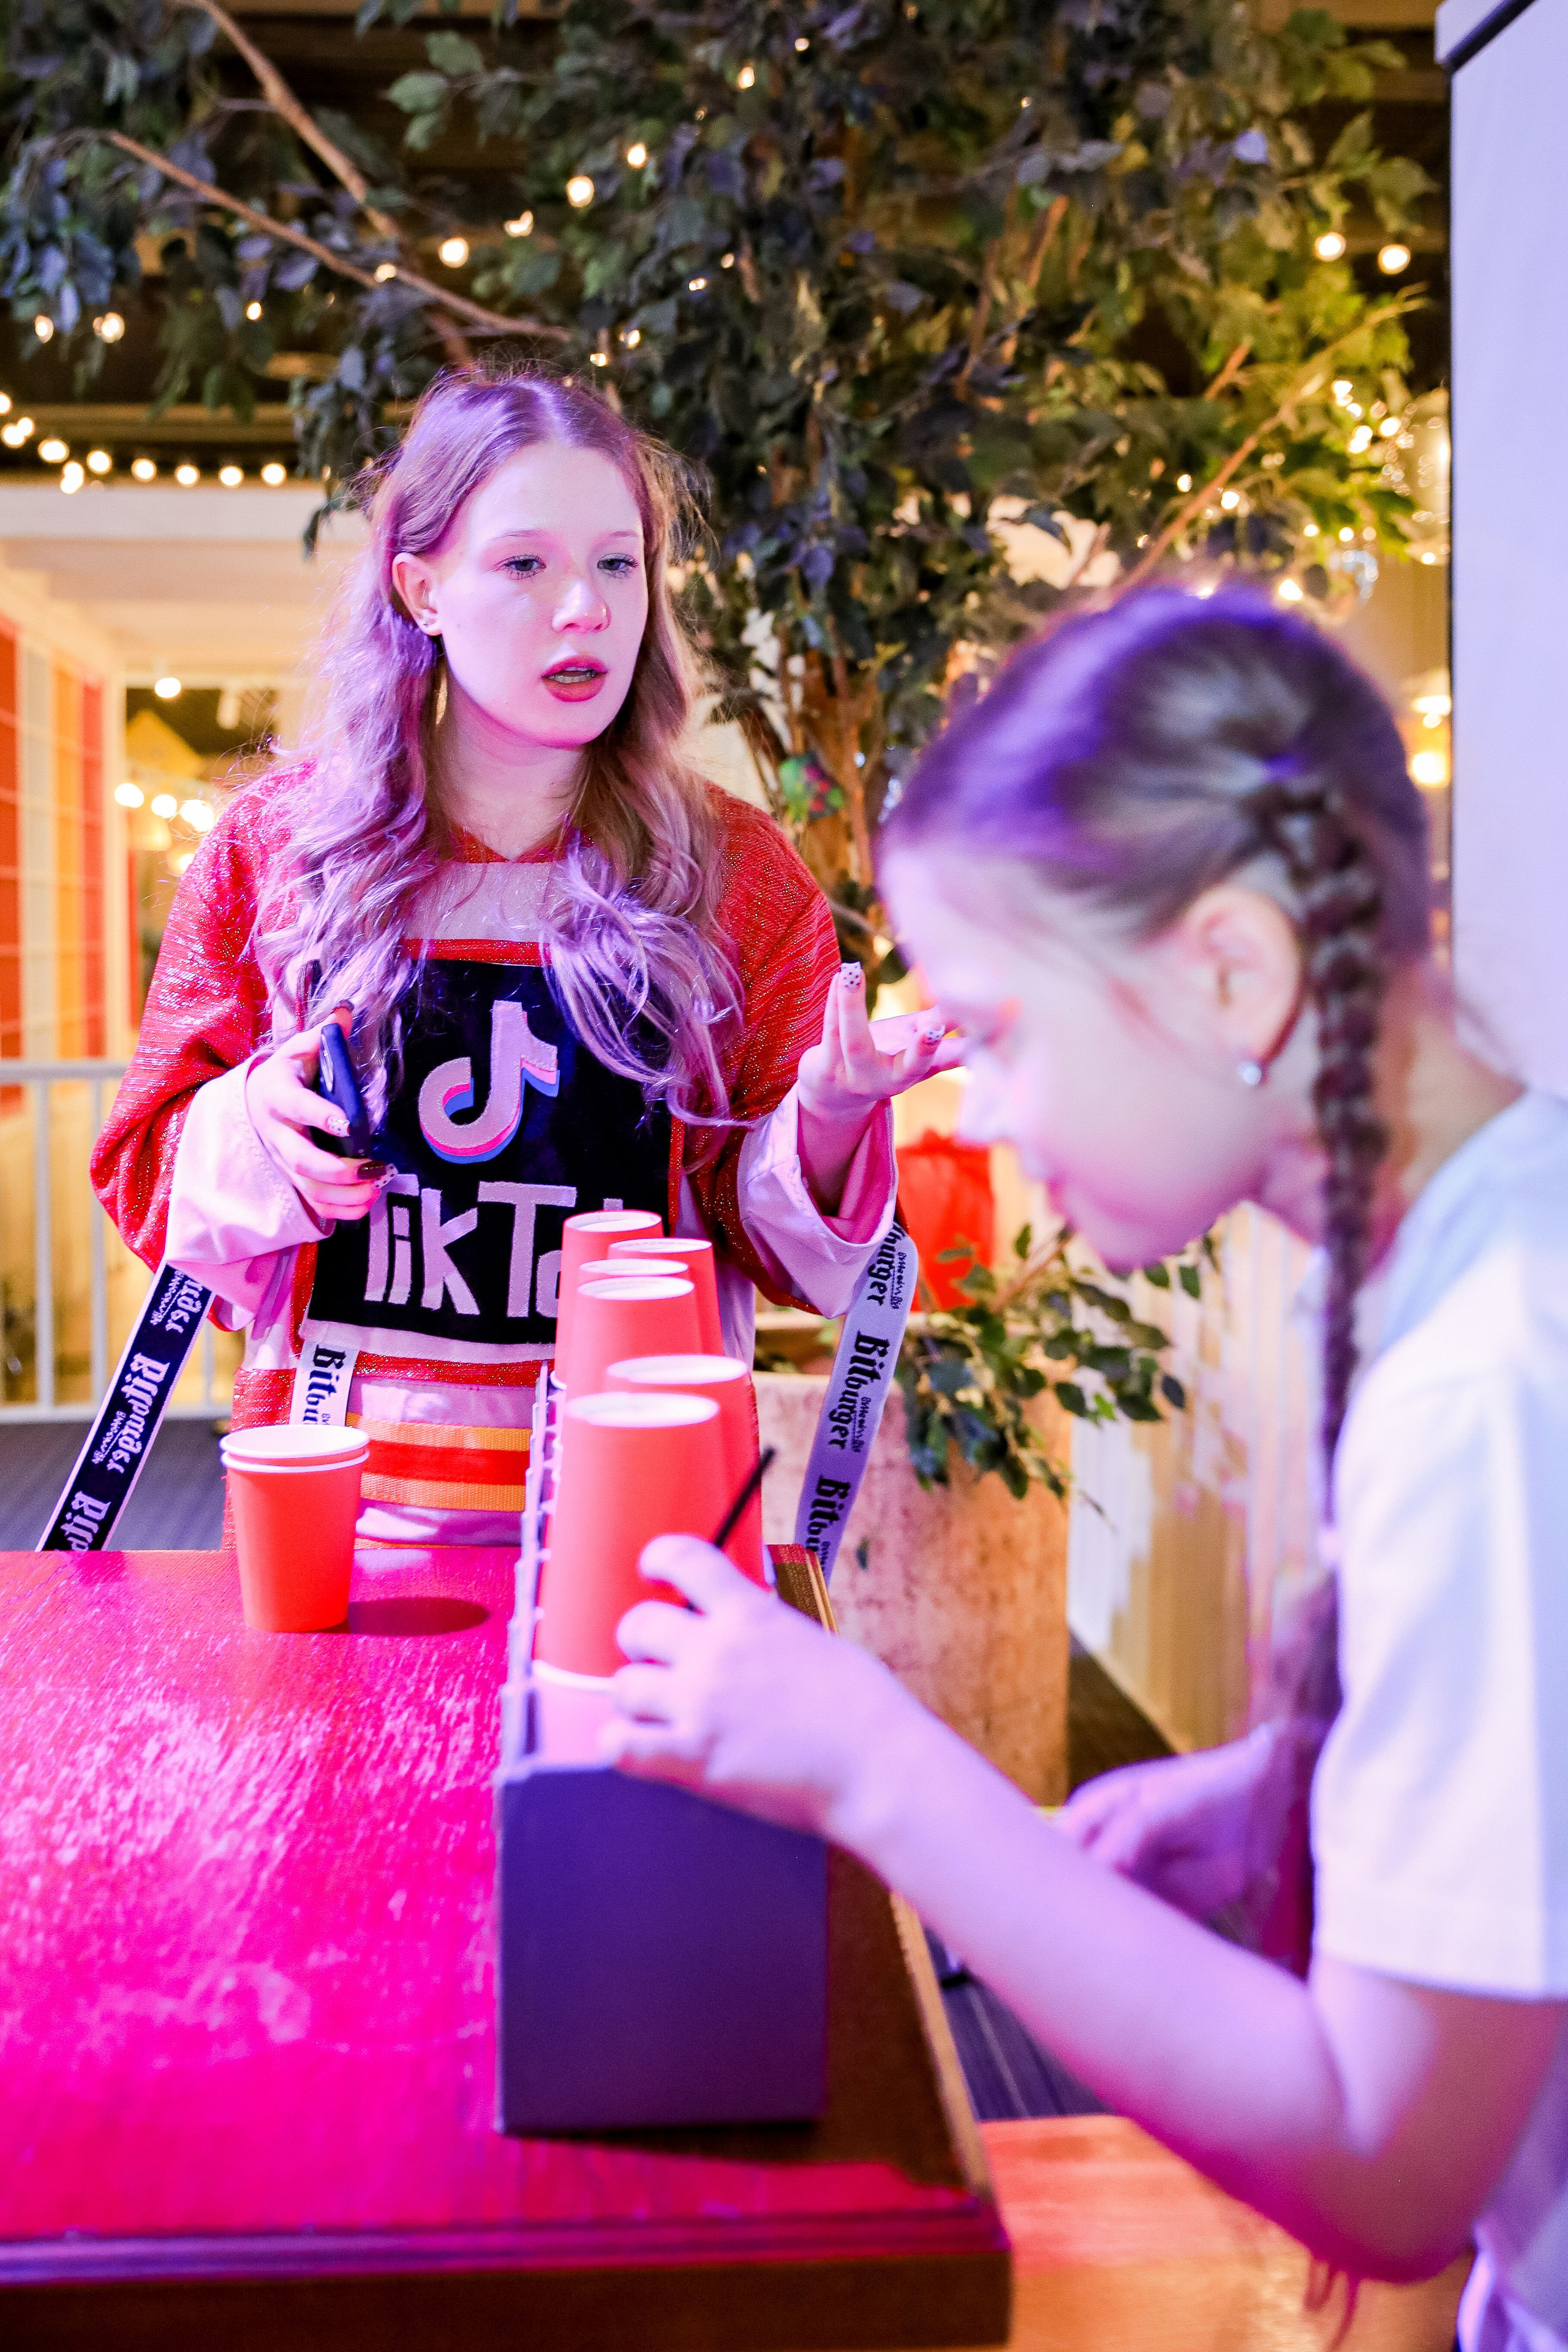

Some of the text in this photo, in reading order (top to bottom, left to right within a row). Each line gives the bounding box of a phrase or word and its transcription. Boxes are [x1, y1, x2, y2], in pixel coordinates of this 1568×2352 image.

[364, 1174, 623, 1318] TikT
[303, 1344, 347, 1425] Bitbu
[829, 1329, 890, 1450] Bitburger
